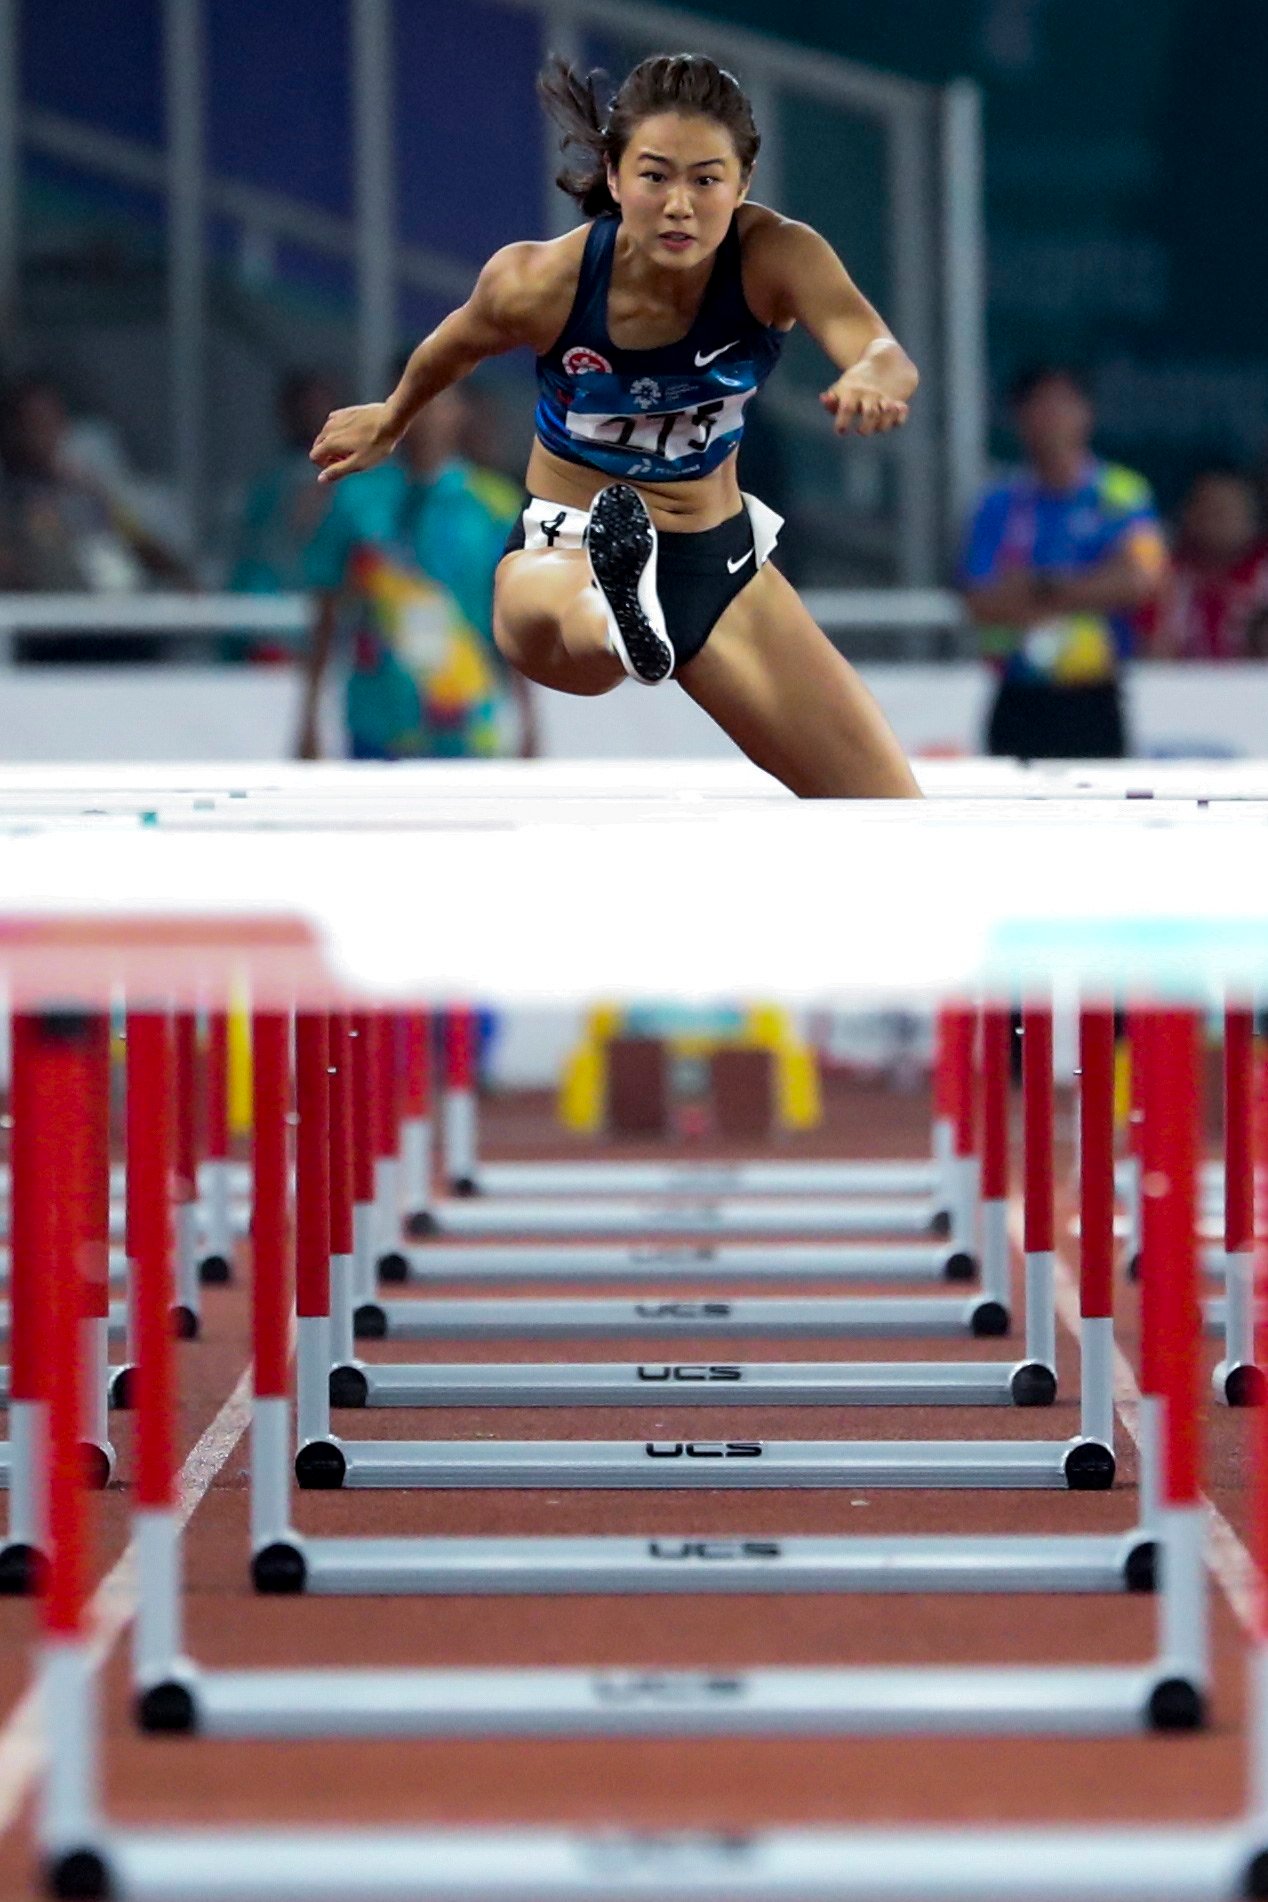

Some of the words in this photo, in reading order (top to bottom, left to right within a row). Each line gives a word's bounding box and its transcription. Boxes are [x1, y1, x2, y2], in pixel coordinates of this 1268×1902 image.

[540, 511, 567, 547] 4
[637, 1365, 743, 1381] UCS
[645, 1442, 763, 1458] UCS
[648, 1541, 781, 1559] UCS
